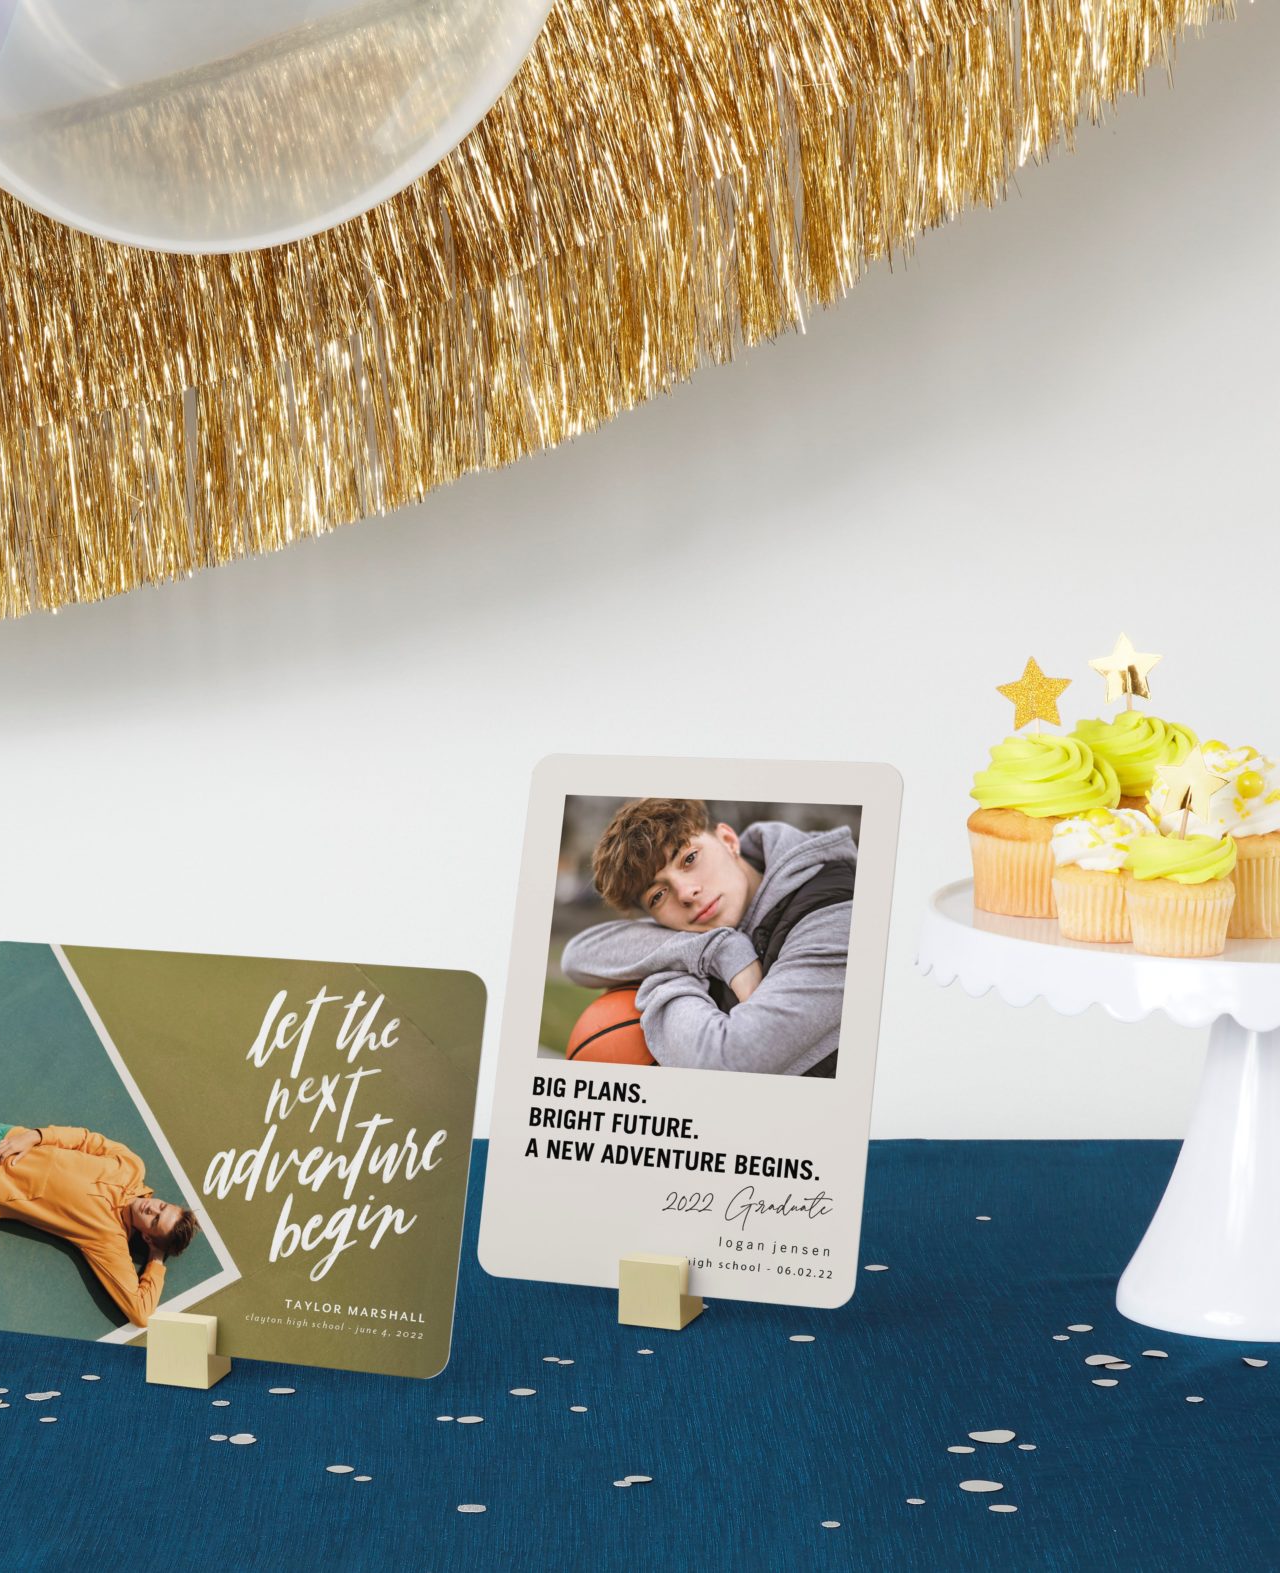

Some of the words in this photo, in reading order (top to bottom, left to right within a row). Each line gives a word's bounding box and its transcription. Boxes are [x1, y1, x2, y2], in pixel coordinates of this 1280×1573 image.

[245, 985, 344, 1079] let
[335, 989, 401, 1064] the
[264, 1066, 382, 1143] next
[532, 1076, 567, 1098] BIG
[573, 1079, 647, 1104] PLANS.
[529, 1107, 605, 1131] BRIGHT
[611, 1113, 699, 1140] FUTURE.
[203, 1113, 448, 1201] adventure
[524, 1138, 539, 1158] A
[546, 1139, 595, 1162] NEW
[600, 1144, 727, 1174] ADVENTURE
[734, 1154, 821, 1181] BEGINS.
[662, 1191, 715, 1213] 2022
[724, 1185, 833, 1231] Graduate
[269, 1193, 418, 1282] begin
[718, 1236, 765, 1252] logan
[771, 1241, 831, 1257] jensen
[718, 1260, 761, 1273] school
[776, 1265, 833, 1280] 06.02.22
[245, 1312, 283, 1326] clayton
[286, 1316, 309, 1329] high
[312, 1320, 344, 1332] school
[354, 1324, 378, 1336] june
[381, 1328, 392, 1338] 4,
[395, 1329, 424, 1341] 2022
[285, 1298, 342, 1315] TAYLOR
[347, 1305, 426, 1324] MARSHALL
